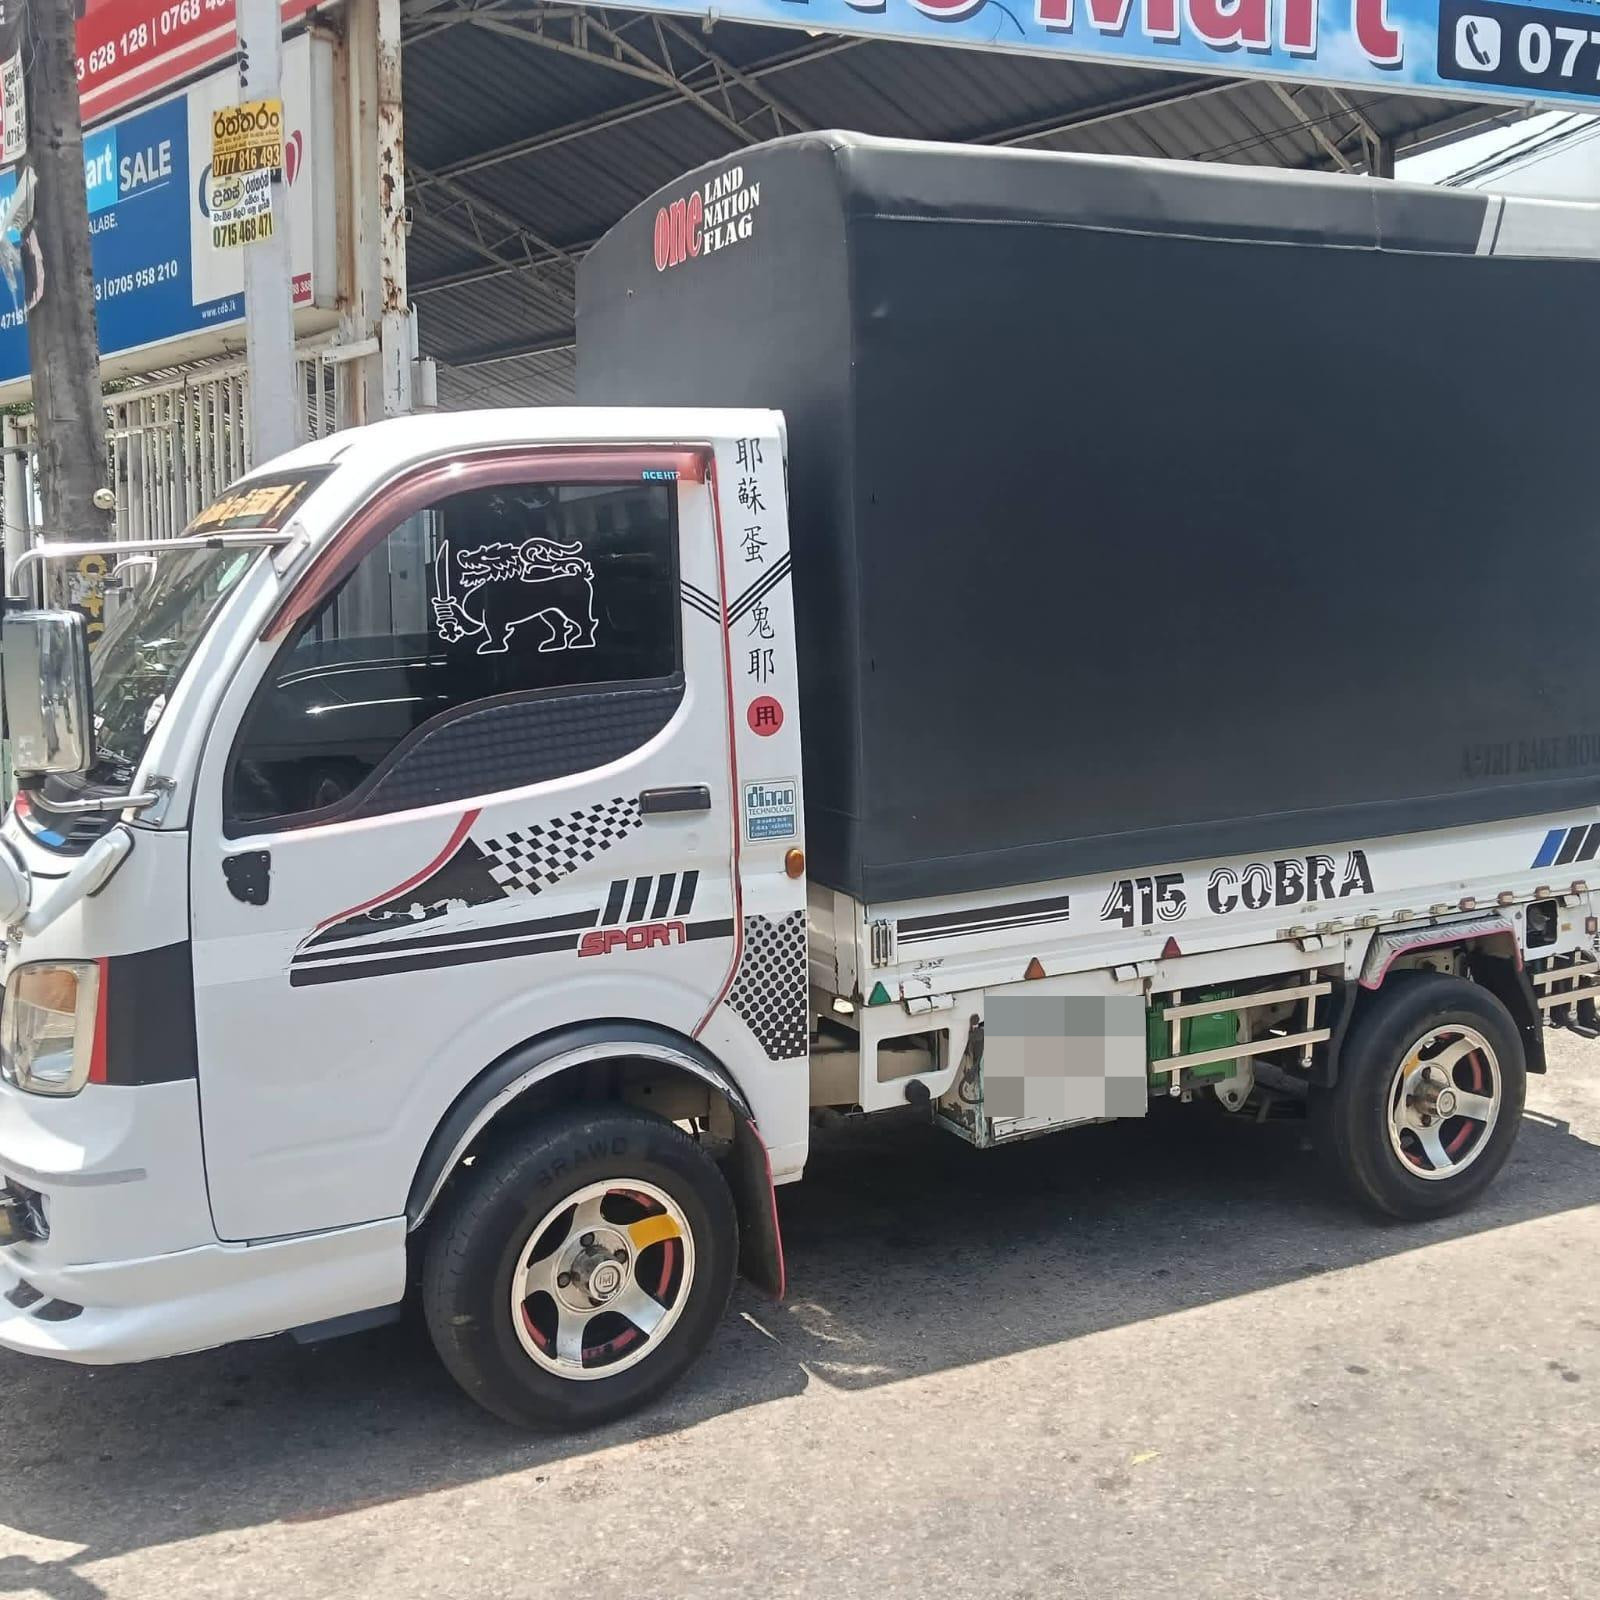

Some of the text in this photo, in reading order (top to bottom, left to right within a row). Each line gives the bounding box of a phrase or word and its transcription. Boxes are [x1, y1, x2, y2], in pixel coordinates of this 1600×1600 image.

[89, 41, 116, 74] 628
[120, 23, 148, 56] 128
[160, 0, 200, 35] 0768
[1518, 22, 1600, 80] 07
[120, 139, 172, 192] SALE
[213, 152, 237, 177] 0777
[239, 147, 258, 172] 816
[260, 144, 280, 168] 493
[704, 166, 744, 205] LAND
[704, 181, 760, 231] NATION
[213, 211, 273, 248] 0715 468 471
[654, 190, 703, 272] one
[703, 213, 753, 256] FLAG
[108, 274, 133, 297] 0705
[135, 266, 155, 289] 958
[157, 259, 178, 282] 210
[1100, 849, 1375, 928] 415 COBRA
[577, 920, 686, 958] SPORT
